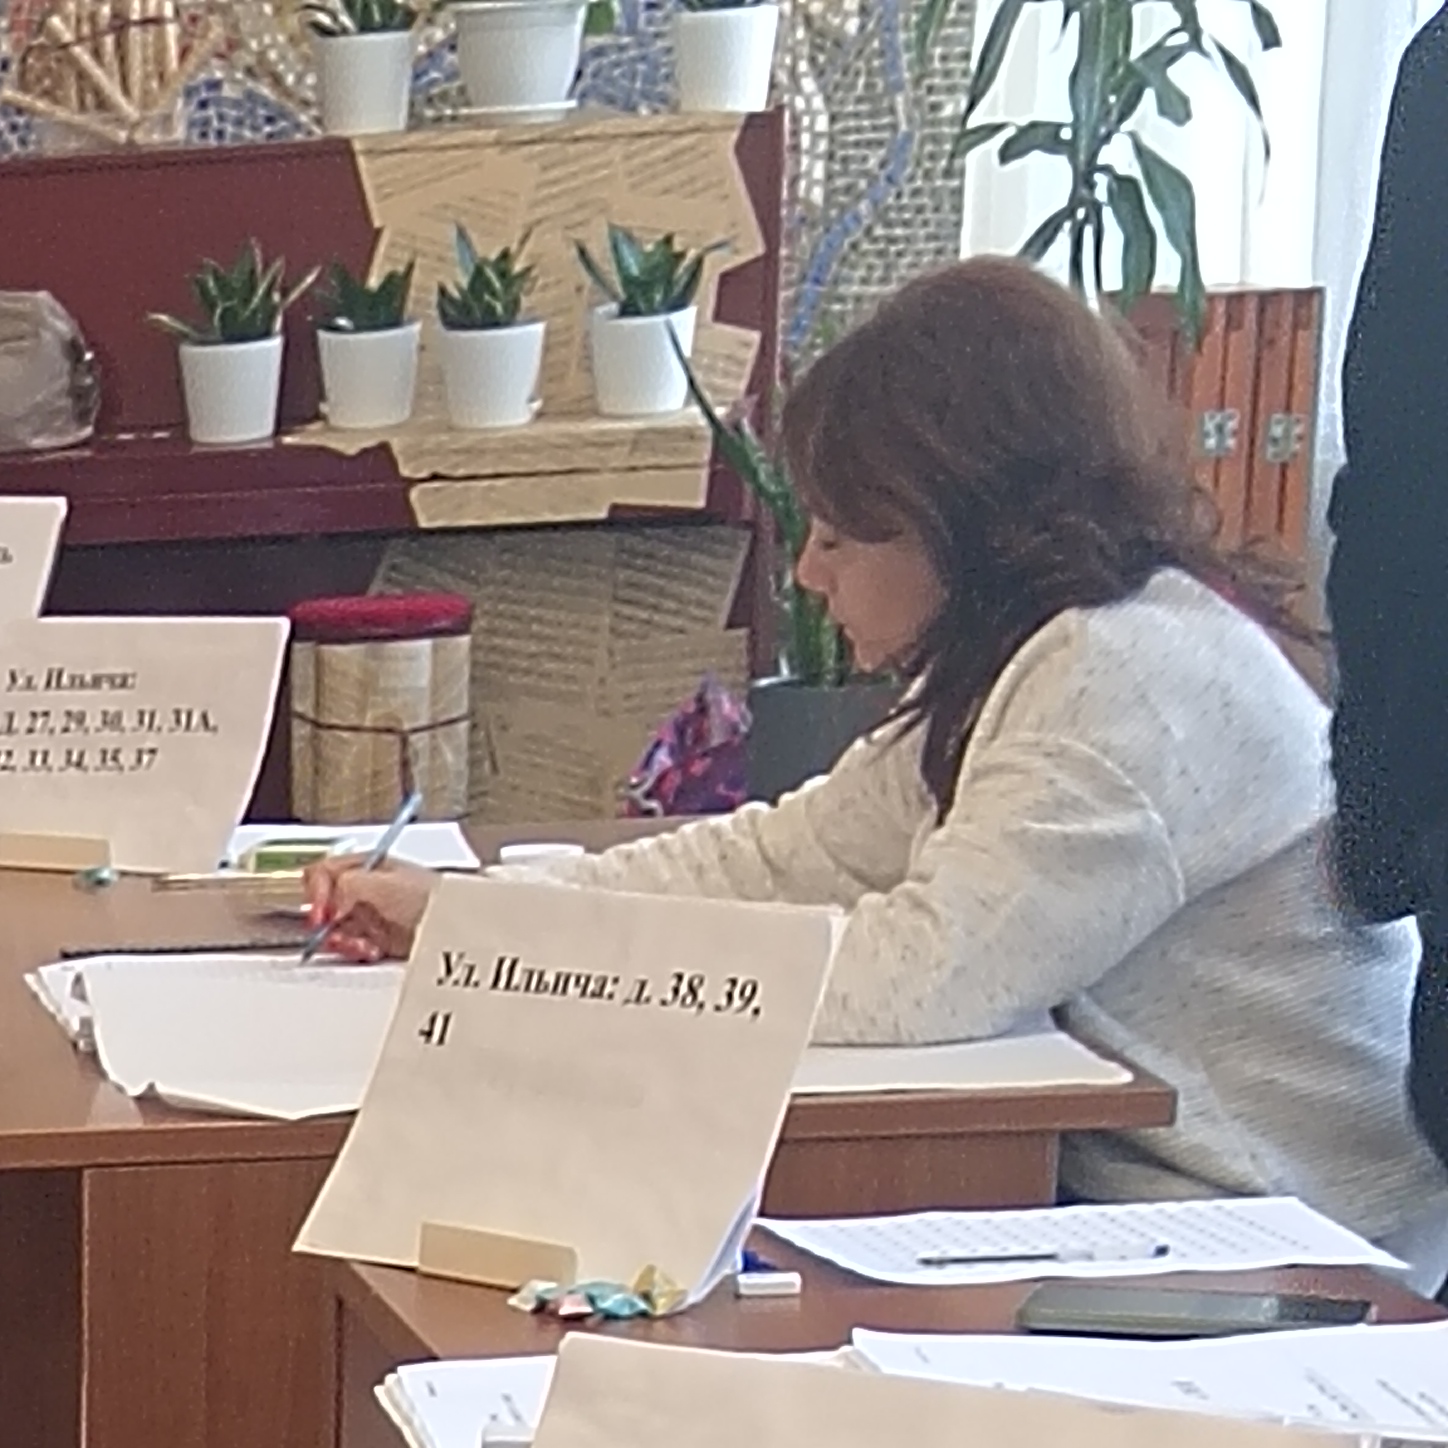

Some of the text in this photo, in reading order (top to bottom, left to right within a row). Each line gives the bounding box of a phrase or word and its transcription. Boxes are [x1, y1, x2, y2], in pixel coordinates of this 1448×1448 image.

[6, 667, 137, 692] Ул. Ильича:
[26, 710, 55, 734] 27,
[61, 710, 89, 735] 29,
[130, 748, 158, 771] 37
[436, 951, 761, 1021] Ул. Ильича: д. 38, 39,
[418, 1011, 452, 1046] 41
